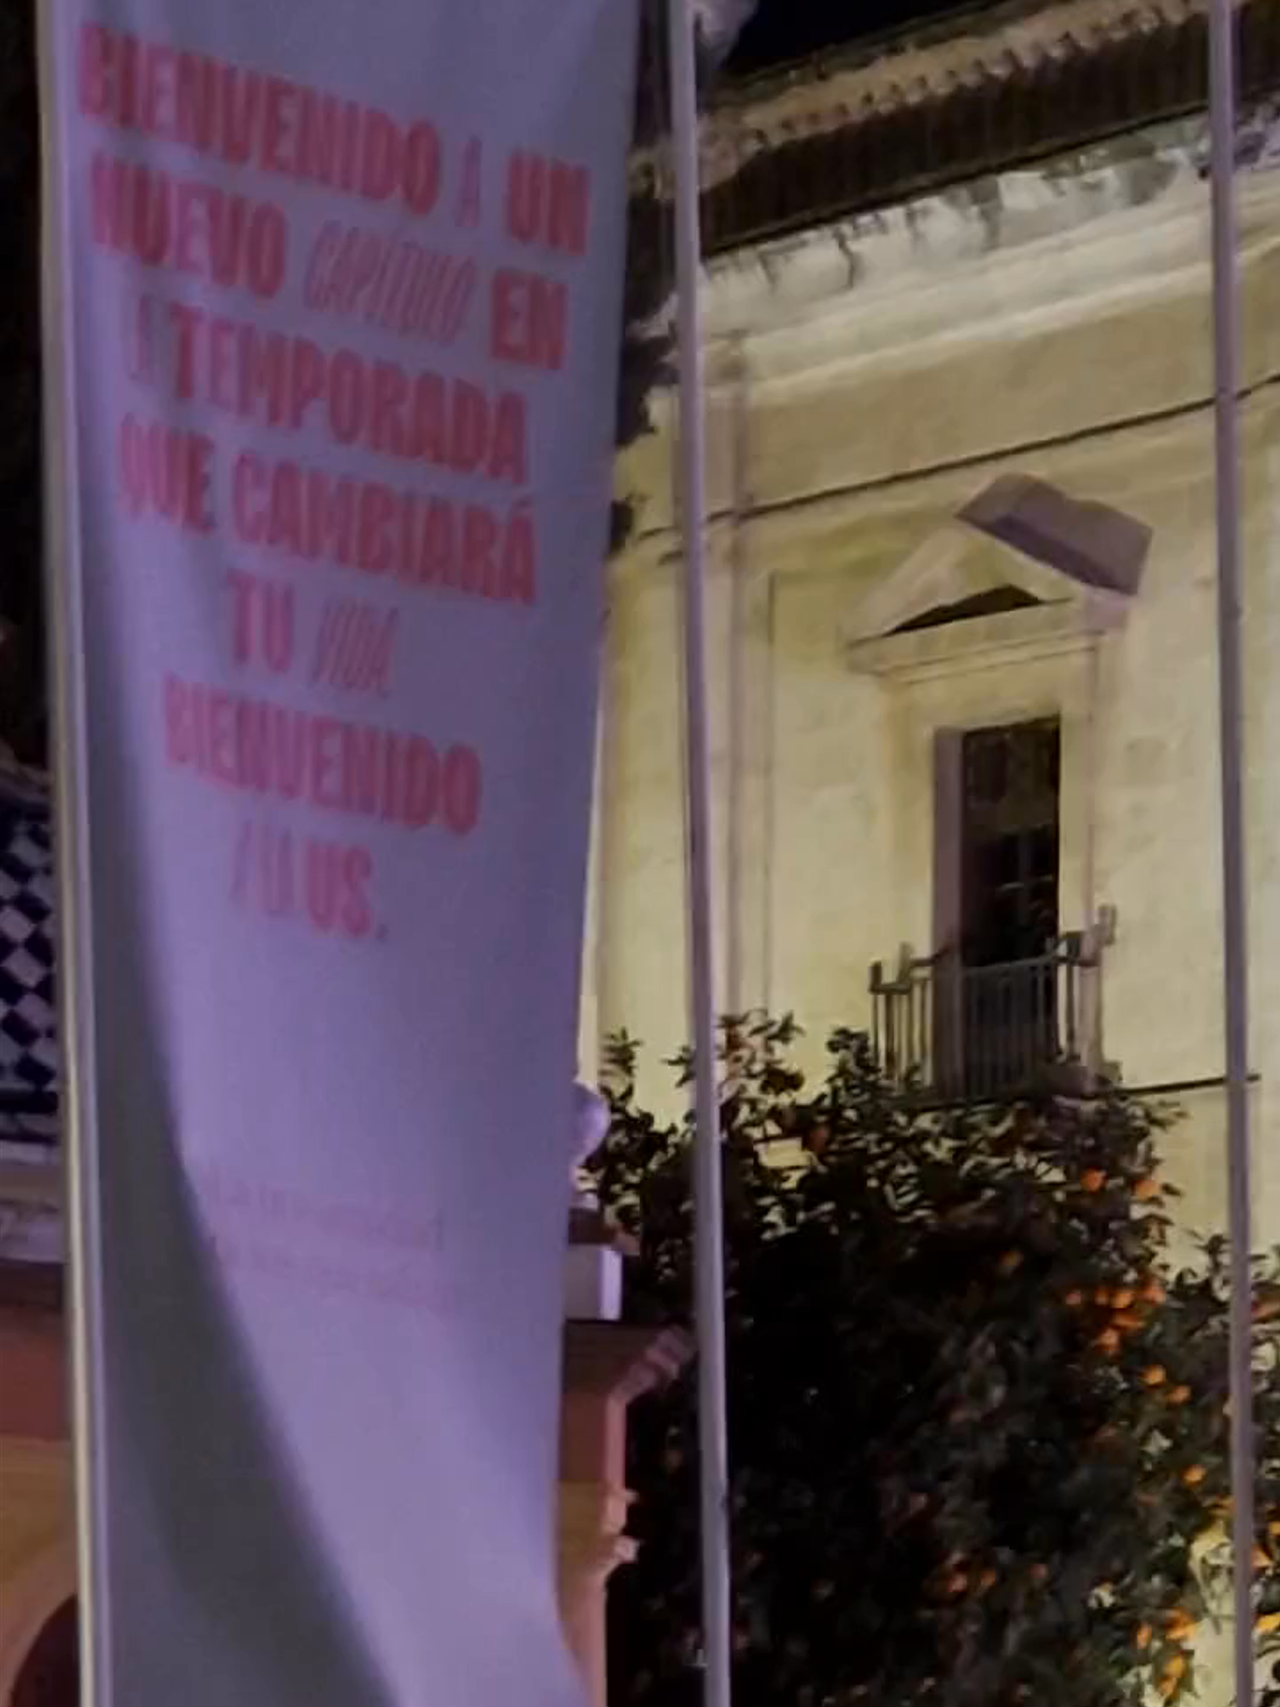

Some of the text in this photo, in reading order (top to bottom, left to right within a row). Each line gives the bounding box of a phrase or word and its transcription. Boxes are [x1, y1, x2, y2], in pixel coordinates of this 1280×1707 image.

[78, 20, 592, 256] BIENVENIDO A UN
[90, 151, 568, 371] NUEVO CAPÍTULO EN
[170, 300, 528, 486] TEMPORADA
[120, 411, 537, 605] QUE CAMBIARÁ
[226, 568, 398, 699] TU VIDA
[163, 669, 482, 837] BIENVENIDO
